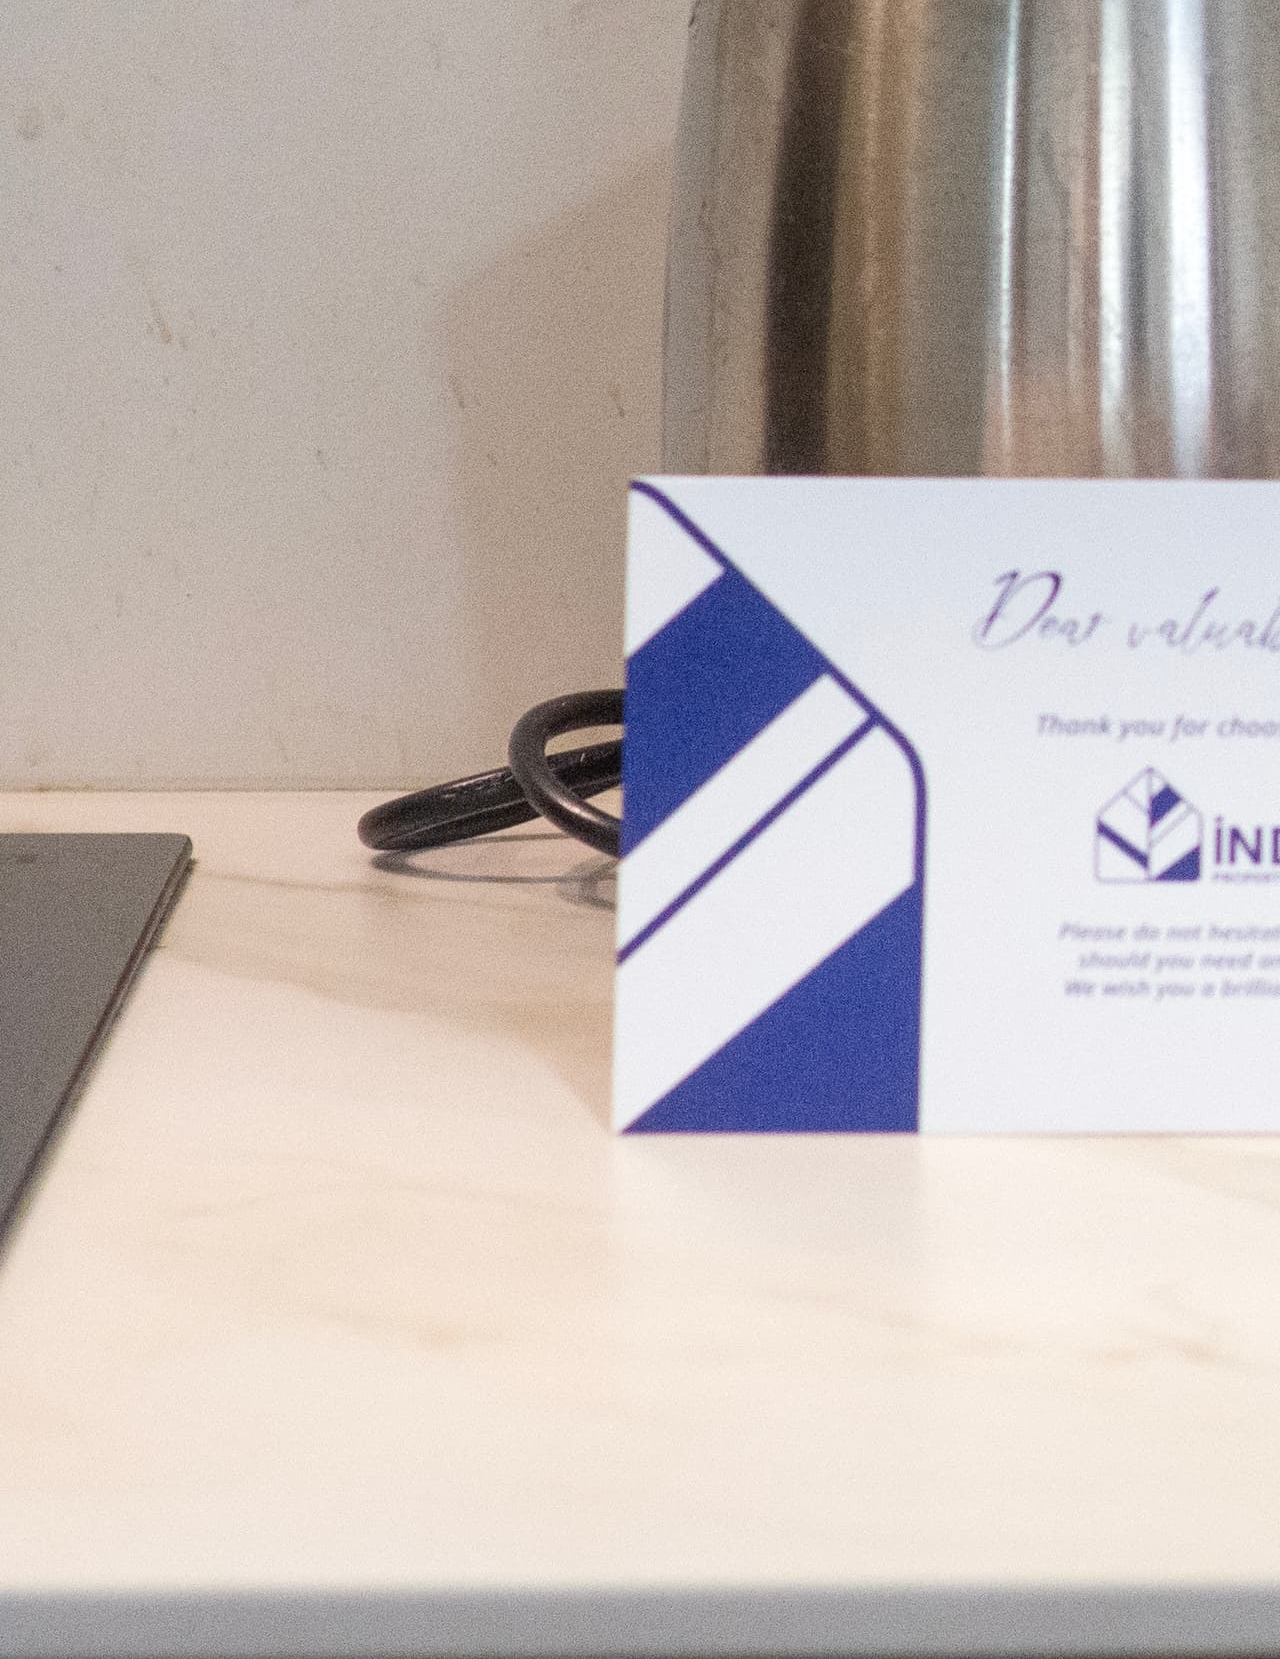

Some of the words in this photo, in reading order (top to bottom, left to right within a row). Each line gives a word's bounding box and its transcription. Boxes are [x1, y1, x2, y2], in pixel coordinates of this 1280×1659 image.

[973, 569, 1107, 651] Dear
[1037, 713, 1112, 737] Thank
[1117, 720, 1164, 742] you
[1168, 714, 1210, 742] for
[1057, 921, 1128, 942] Please
[1132, 922, 1162, 942] do
[1166, 925, 1203, 942] not
[1078, 951, 1151, 969] should
[1154, 957, 1195, 974] you
[1199, 953, 1254, 969] need
[1064, 979, 1097, 997] We
[1101, 979, 1152, 998] wish
[1155, 982, 1196, 1002] you
[1200, 982, 1216, 998] a
